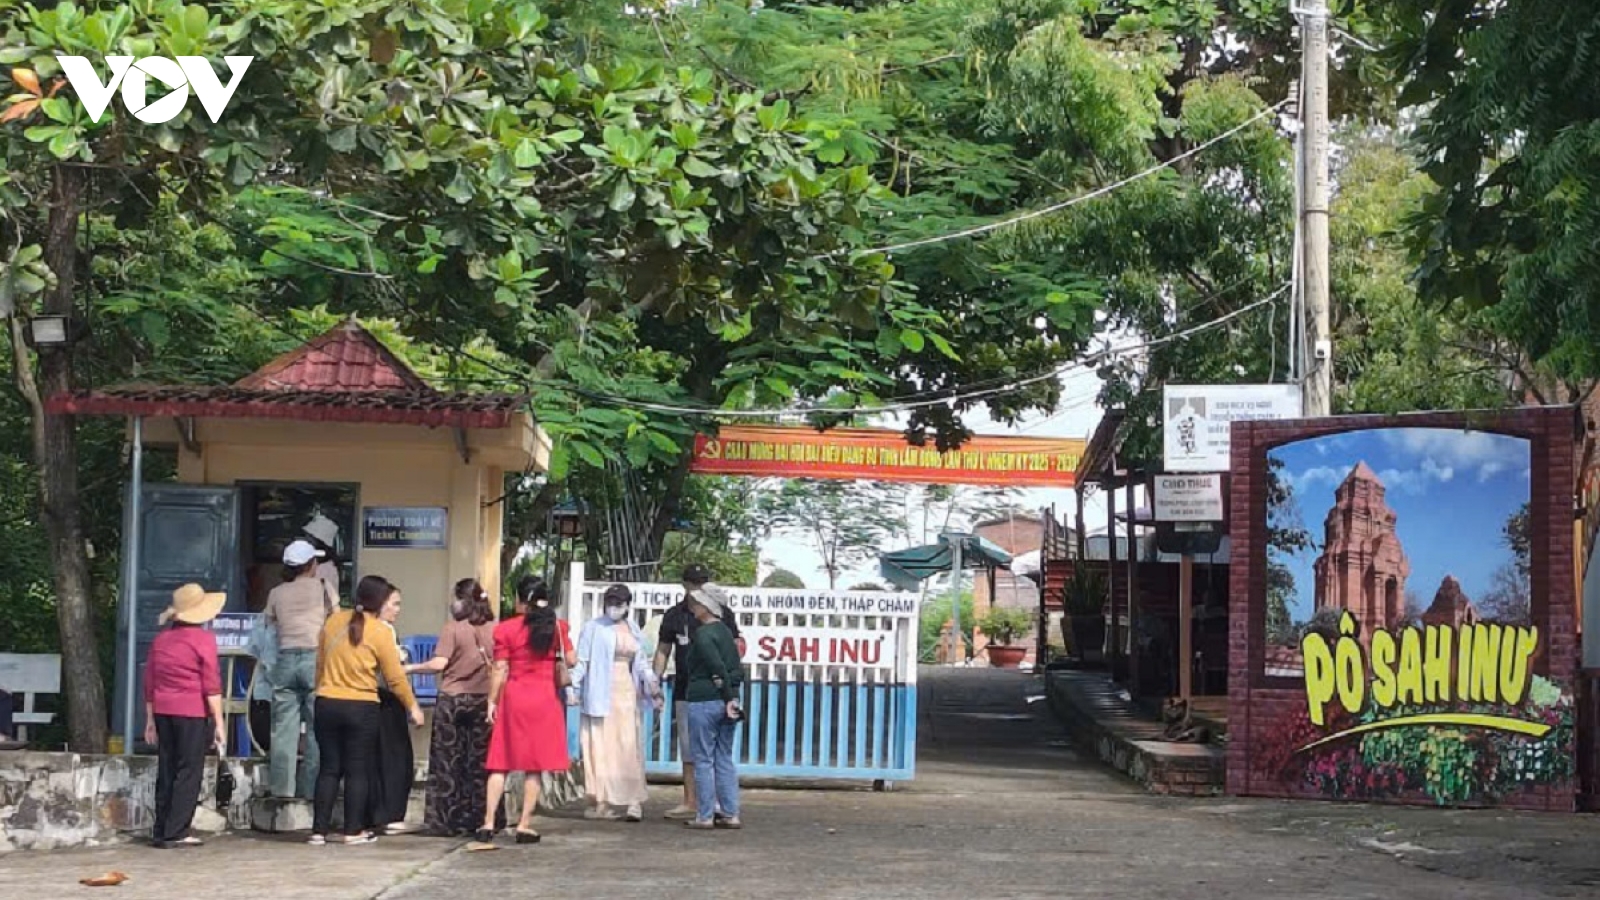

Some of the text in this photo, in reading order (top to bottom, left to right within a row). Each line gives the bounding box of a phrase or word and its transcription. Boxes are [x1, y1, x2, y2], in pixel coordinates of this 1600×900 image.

[1029, 453, 1049, 471] 2025
[643, 590, 671, 606] TÍCH
[741, 594, 762, 609] GIA
[767, 593, 805, 610] NHÓM
[841, 595, 874, 612] THÁP
[758, 635, 820, 663] SAH
[1303, 611, 1538, 726] PÔ SAH INƯ
